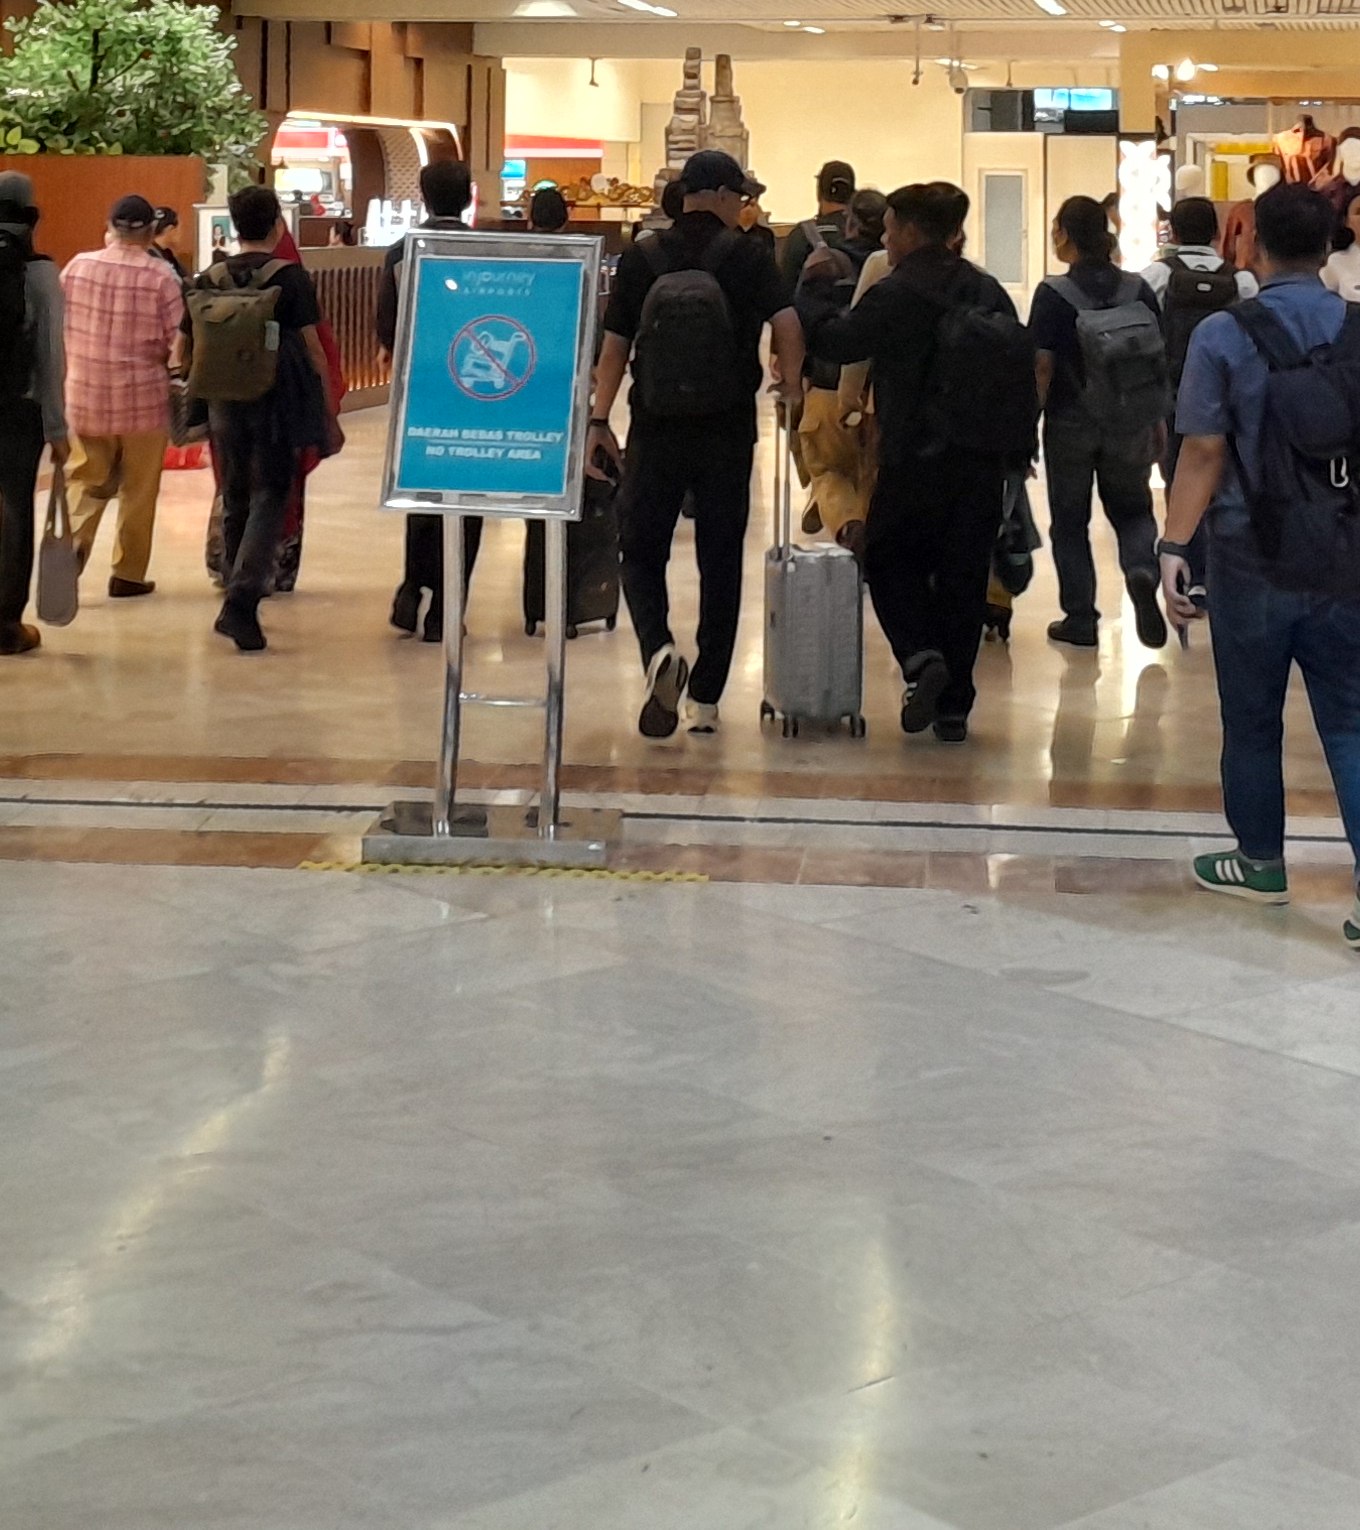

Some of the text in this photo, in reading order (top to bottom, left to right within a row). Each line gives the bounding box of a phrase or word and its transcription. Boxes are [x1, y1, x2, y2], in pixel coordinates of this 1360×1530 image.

[407, 427, 565, 444] DAERAH BEBAS TROLLEY
[425, 445, 542, 461] NO TROLLEY AREA
